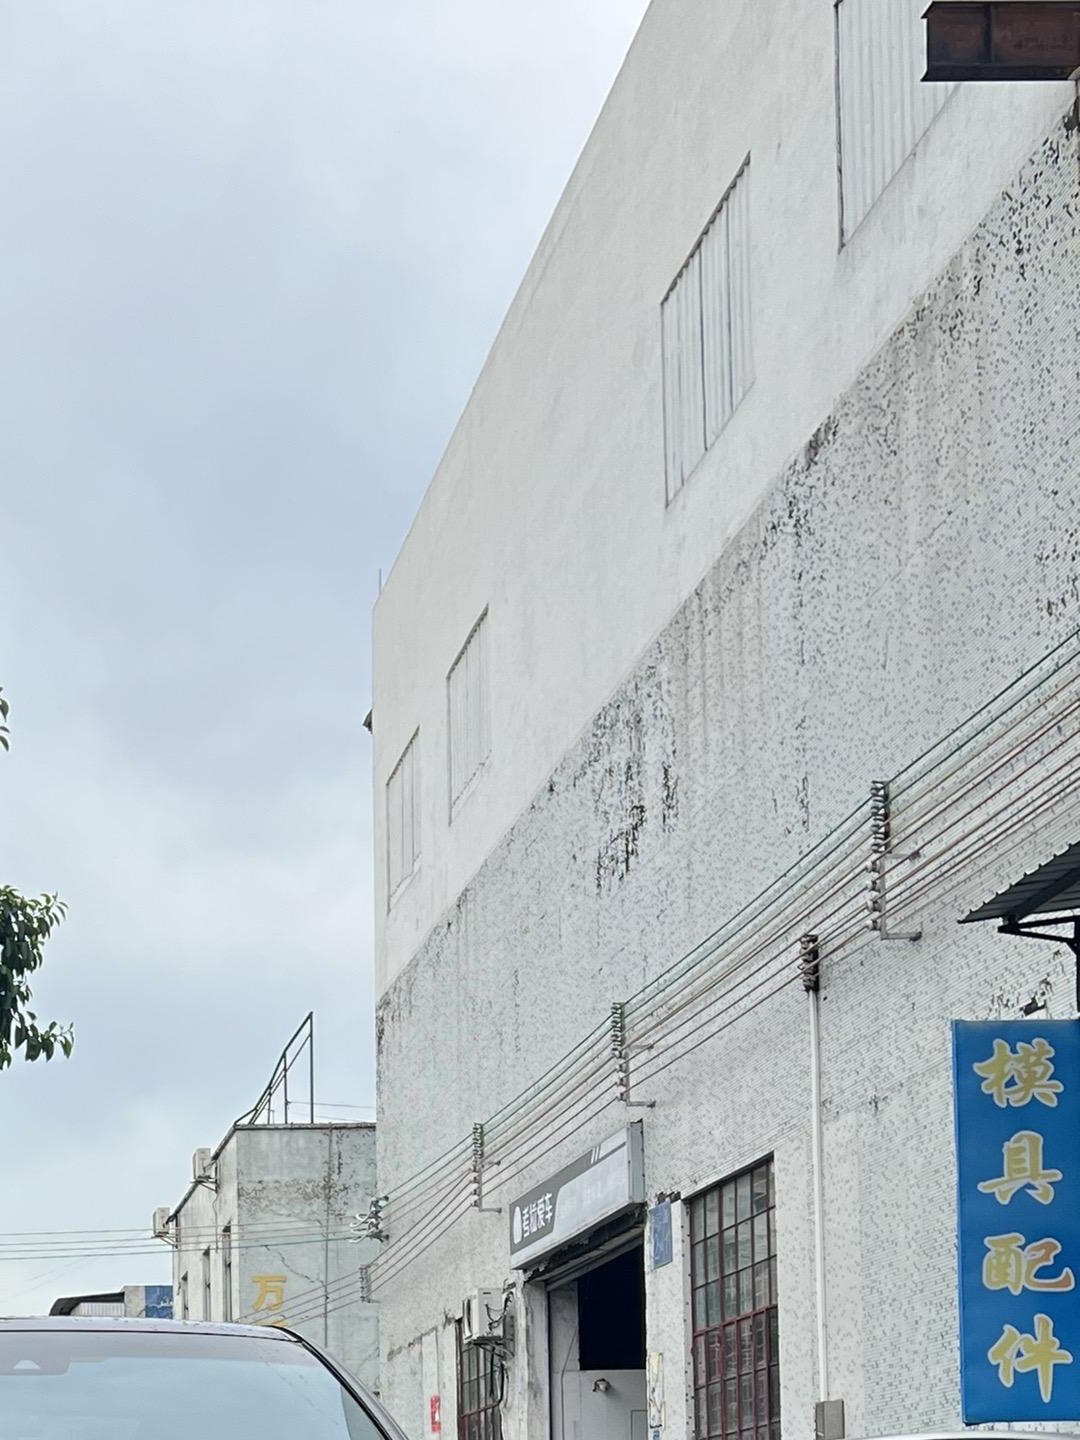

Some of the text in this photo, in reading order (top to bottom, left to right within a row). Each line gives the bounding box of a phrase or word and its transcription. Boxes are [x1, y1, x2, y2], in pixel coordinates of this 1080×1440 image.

[251, 1275, 288, 1327] 万
[972, 1037, 1075, 1402] 模具配件
